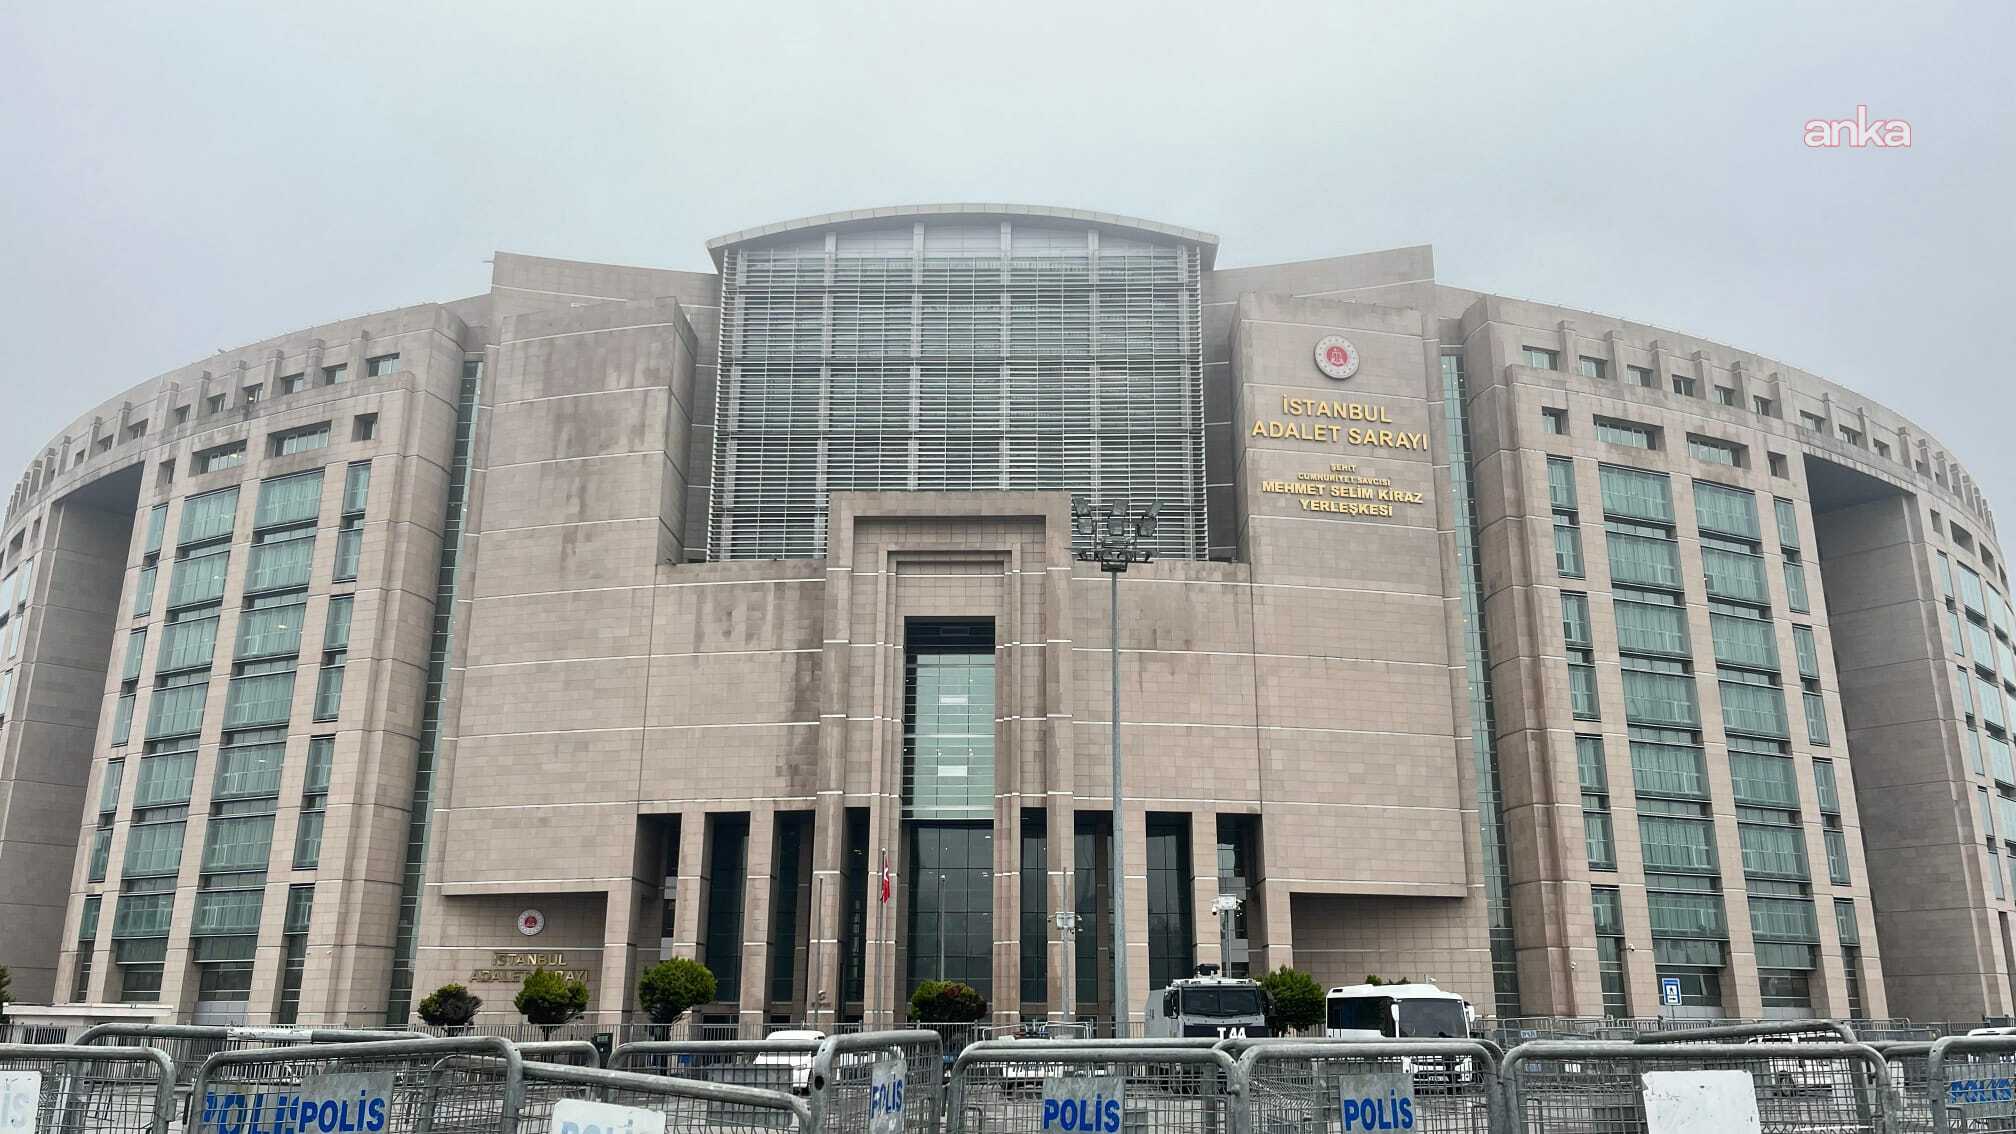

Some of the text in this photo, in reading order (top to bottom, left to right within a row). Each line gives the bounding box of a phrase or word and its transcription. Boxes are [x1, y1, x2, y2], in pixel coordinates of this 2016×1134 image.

[1282, 394, 1393, 423] İSTANBUL
[1251, 420, 1428, 451] ADALET SARAYI
[1262, 480, 1325, 497] MEHMET
[1330, 484, 1374, 500] SELİM
[1299, 496, 1393, 518] YERLEŞKESİ
[1217, 1027, 1247, 1040] T 44
[299, 1090, 385, 1133] POLİS
[869, 1074, 903, 1118] POLİS
[1343, 1089, 1414, 1132] POLİS
[1043, 1093, 1120, 1133] POLİS
